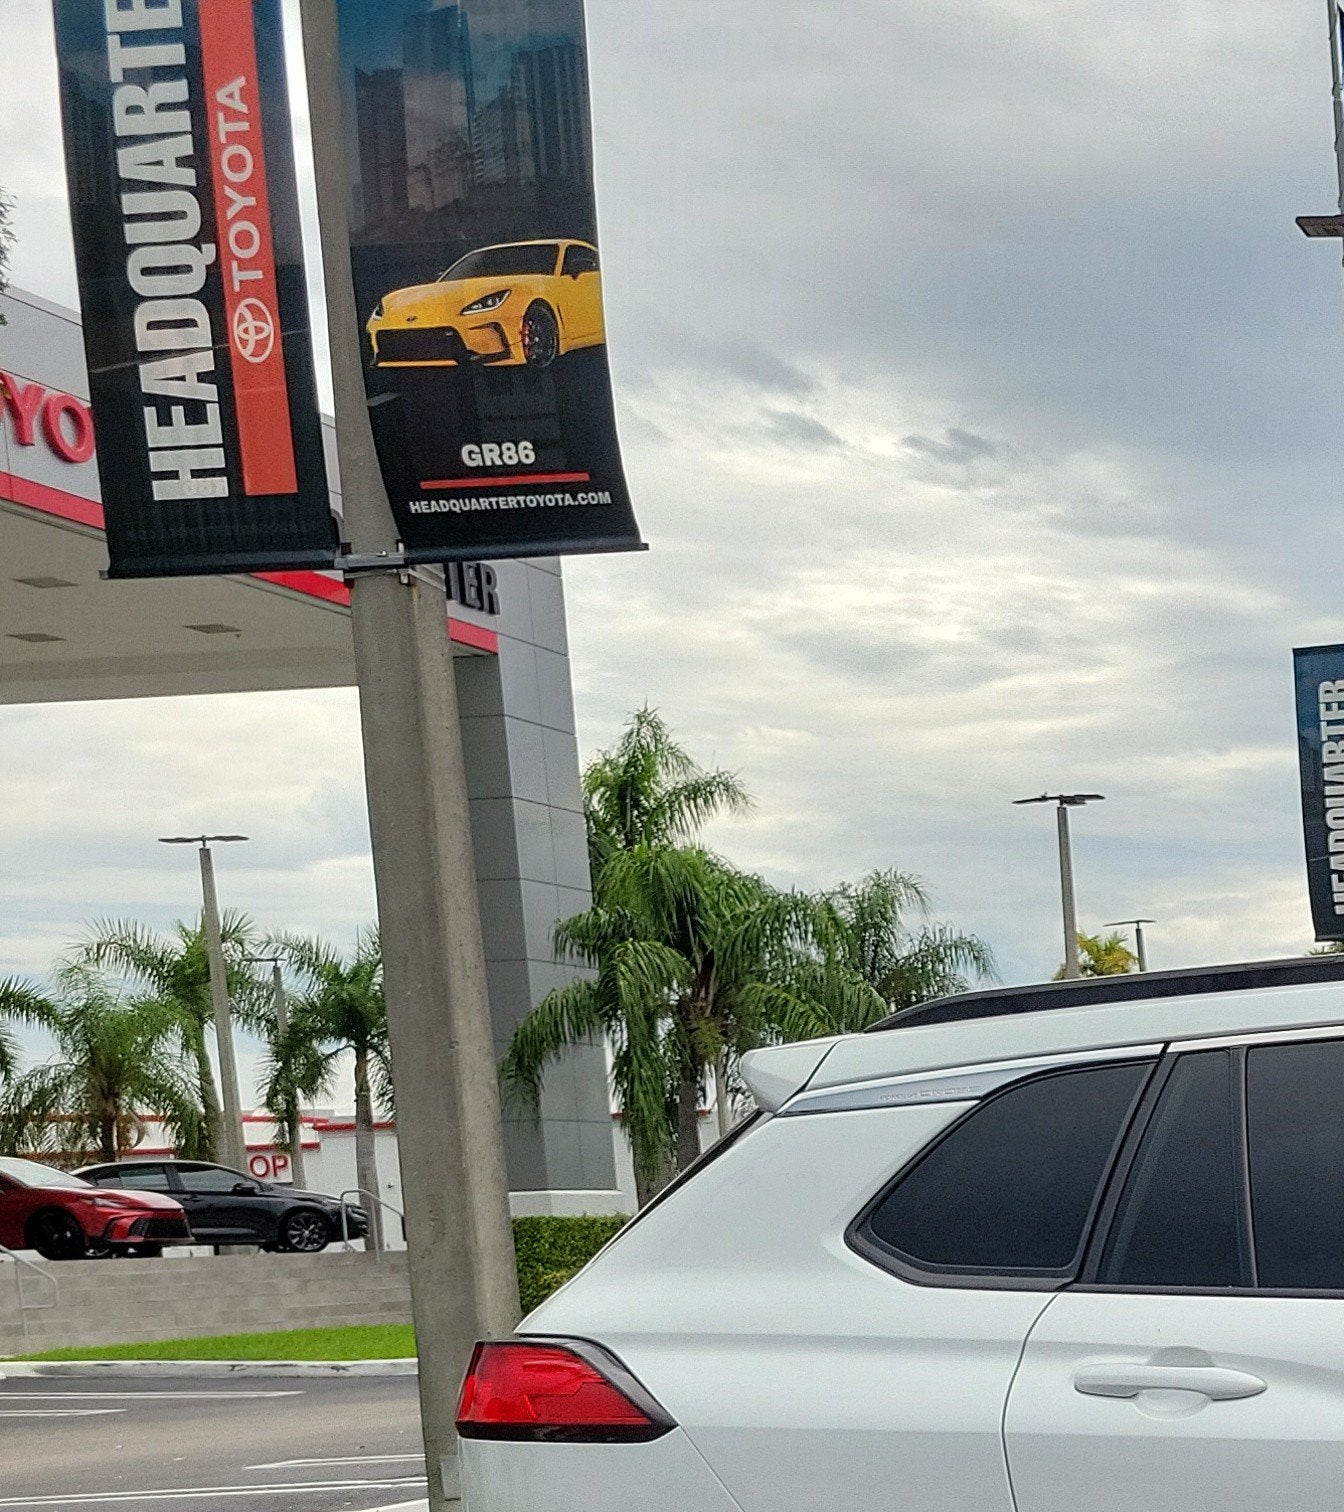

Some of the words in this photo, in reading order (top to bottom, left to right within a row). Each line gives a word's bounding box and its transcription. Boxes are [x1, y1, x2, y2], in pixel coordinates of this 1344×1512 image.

[215, 75, 264, 292] TOYOTA
[461, 441, 536, 467] GR86
[409, 491, 612, 514] HEADQUARTERTOYOTA.COM
